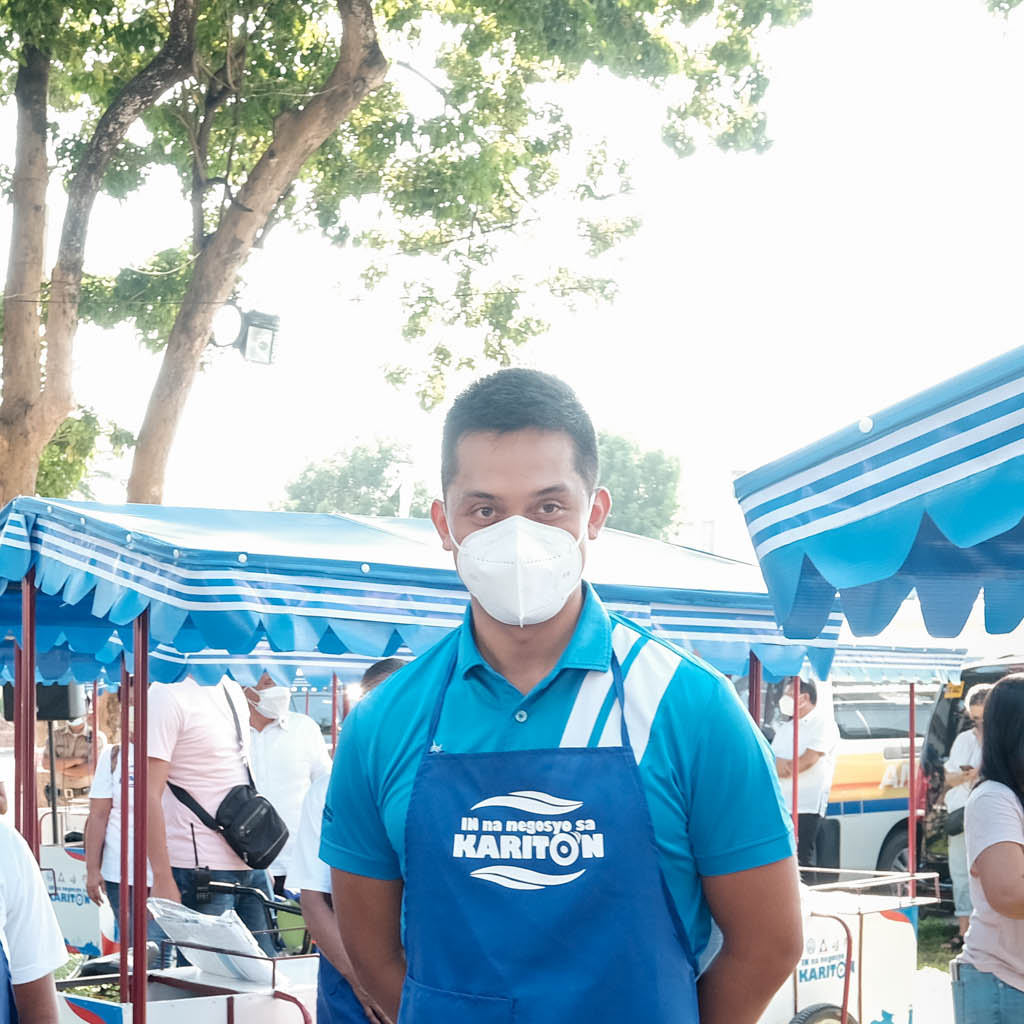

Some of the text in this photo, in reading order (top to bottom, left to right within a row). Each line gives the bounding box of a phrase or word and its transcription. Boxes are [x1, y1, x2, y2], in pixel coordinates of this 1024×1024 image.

[461, 817, 596, 835] IN na negosyo sa
[453, 832, 604, 866] KARITON
